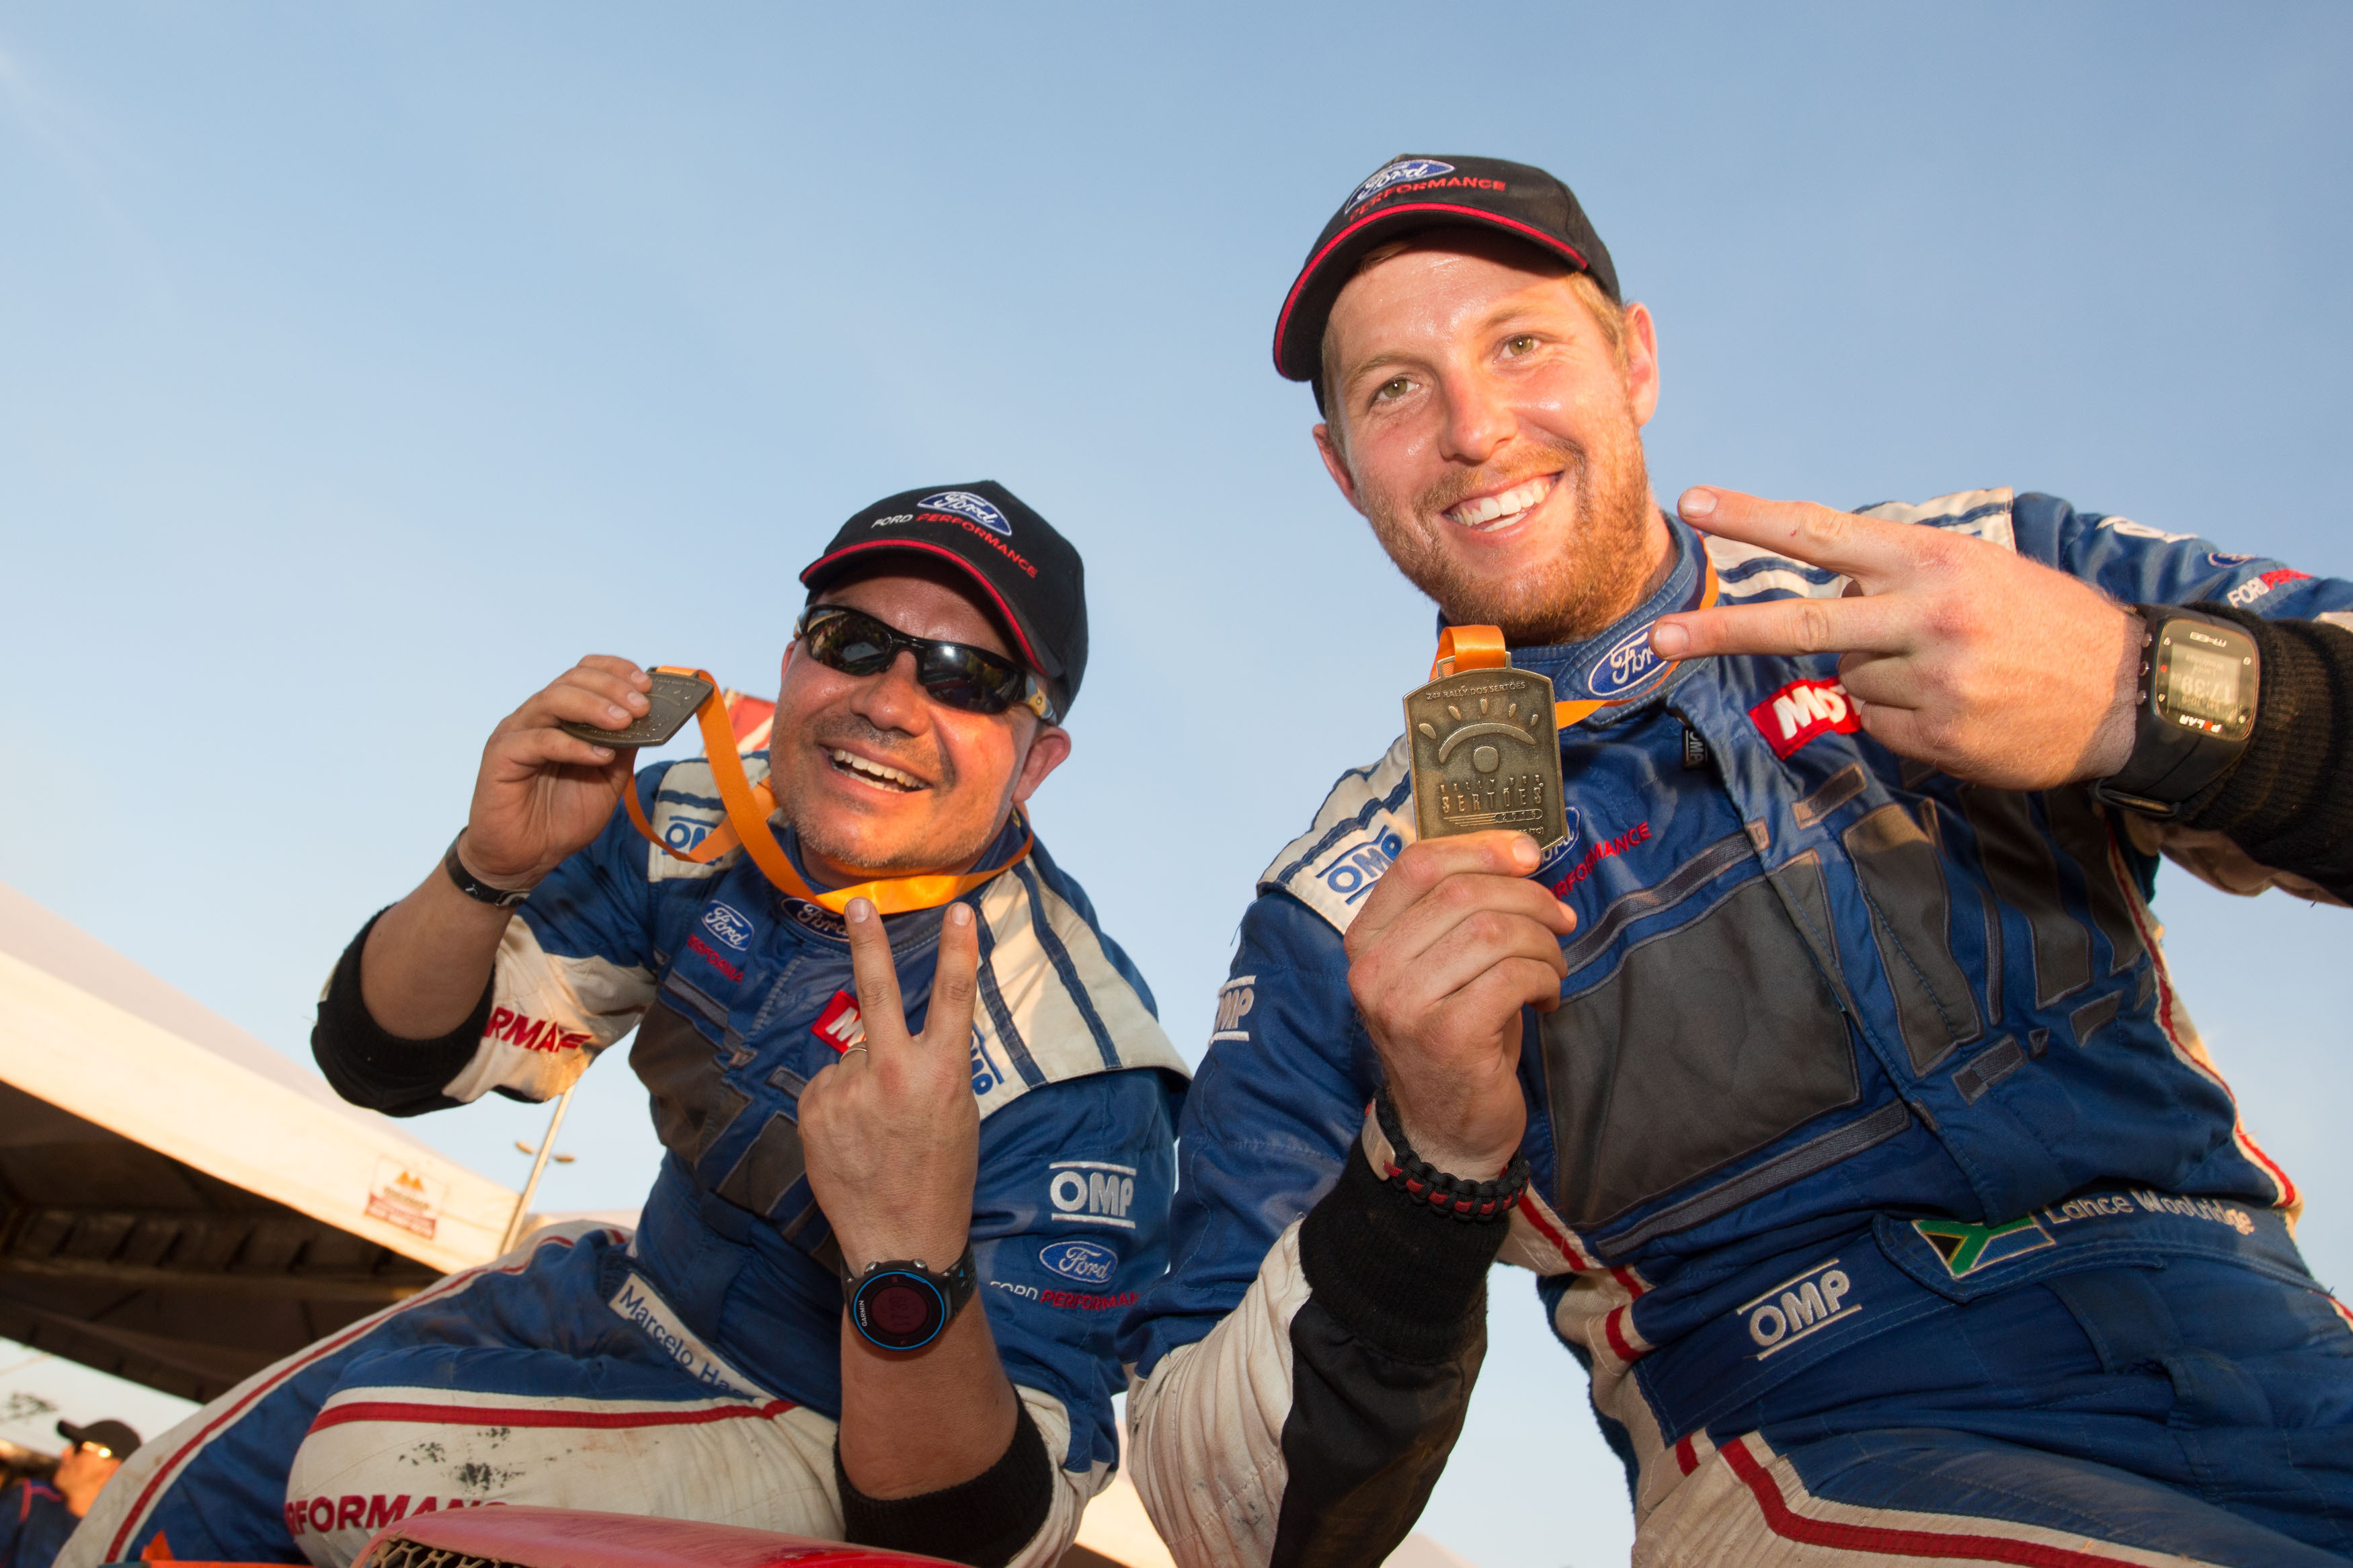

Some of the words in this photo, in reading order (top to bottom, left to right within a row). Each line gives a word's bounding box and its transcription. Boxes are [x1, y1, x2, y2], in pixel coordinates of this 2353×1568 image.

[1349, 177, 1506, 222] PERFORMANCE
[1357, 163, 1429, 201] Ford
[934, 493, 999, 524] Ford
[871, 514, 913, 528] FORD
[916, 513, 1038, 579] PERFORMANCE
[1610, 632, 1655, 684] For
[1442, 688, 1468, 698] RALLY
[1470, 686, 1487, 696] DOS
[2179, 714, 2223, 733] POLAR
[1442, 786, 1542, 814] SERTÕES
[1502, 811, 1536, 821] 2016
[1327, 833, 1402, 893] OMP
[705, 907, 750, 946] Ford
[1050, 1170, 1133, 1217] OMP
[2044, 1194, 2134, 1225] Lance
[1059, 1246, 1112, 1280] Ford
[619, 1285, 693, 1367] Marcelo
[859, 1300, 868, 1327] GARMIN
[1750, 1270, 1849, 1346] OMP
